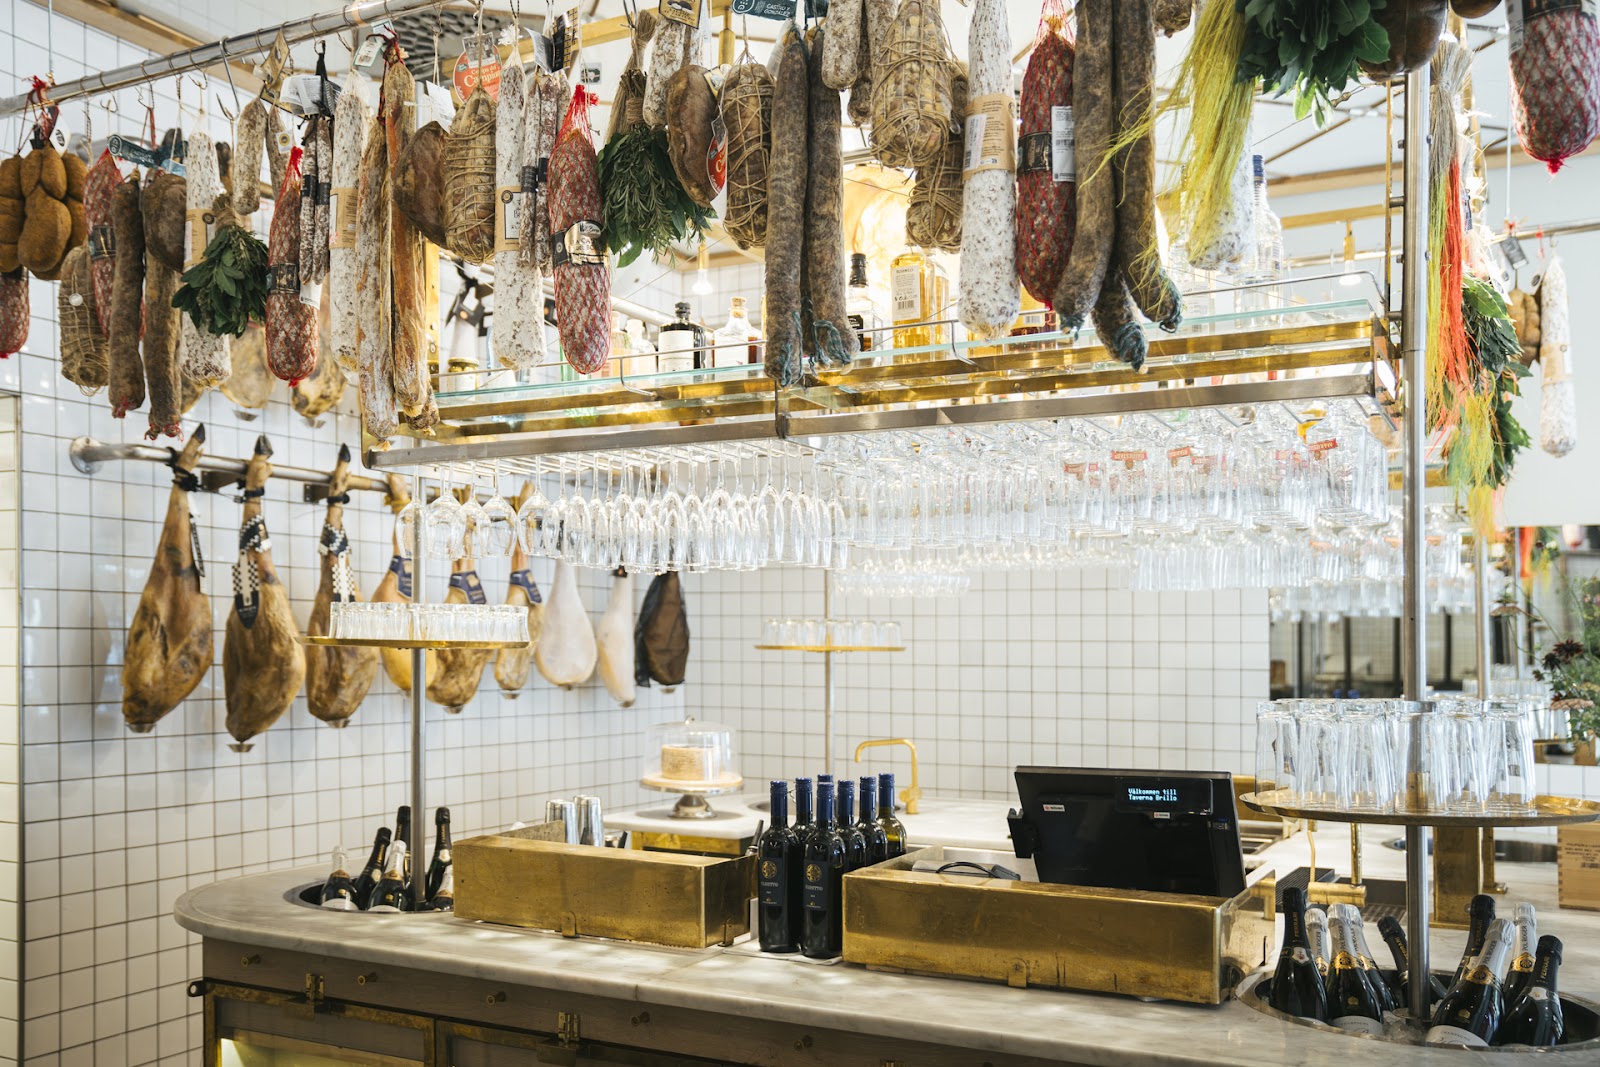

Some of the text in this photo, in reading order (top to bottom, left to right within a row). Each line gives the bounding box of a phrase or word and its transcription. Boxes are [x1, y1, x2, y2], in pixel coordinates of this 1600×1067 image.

[1292, 911, 1300, 938] FERRARI
[1474, 918, 1483, 946] FERRARI
[1485, 939, 1498, 956] ROGER
[1539, 956, 1549, 980] FERRARI
[1440, 1030, 1471, 1042] CHAMPAGNE
